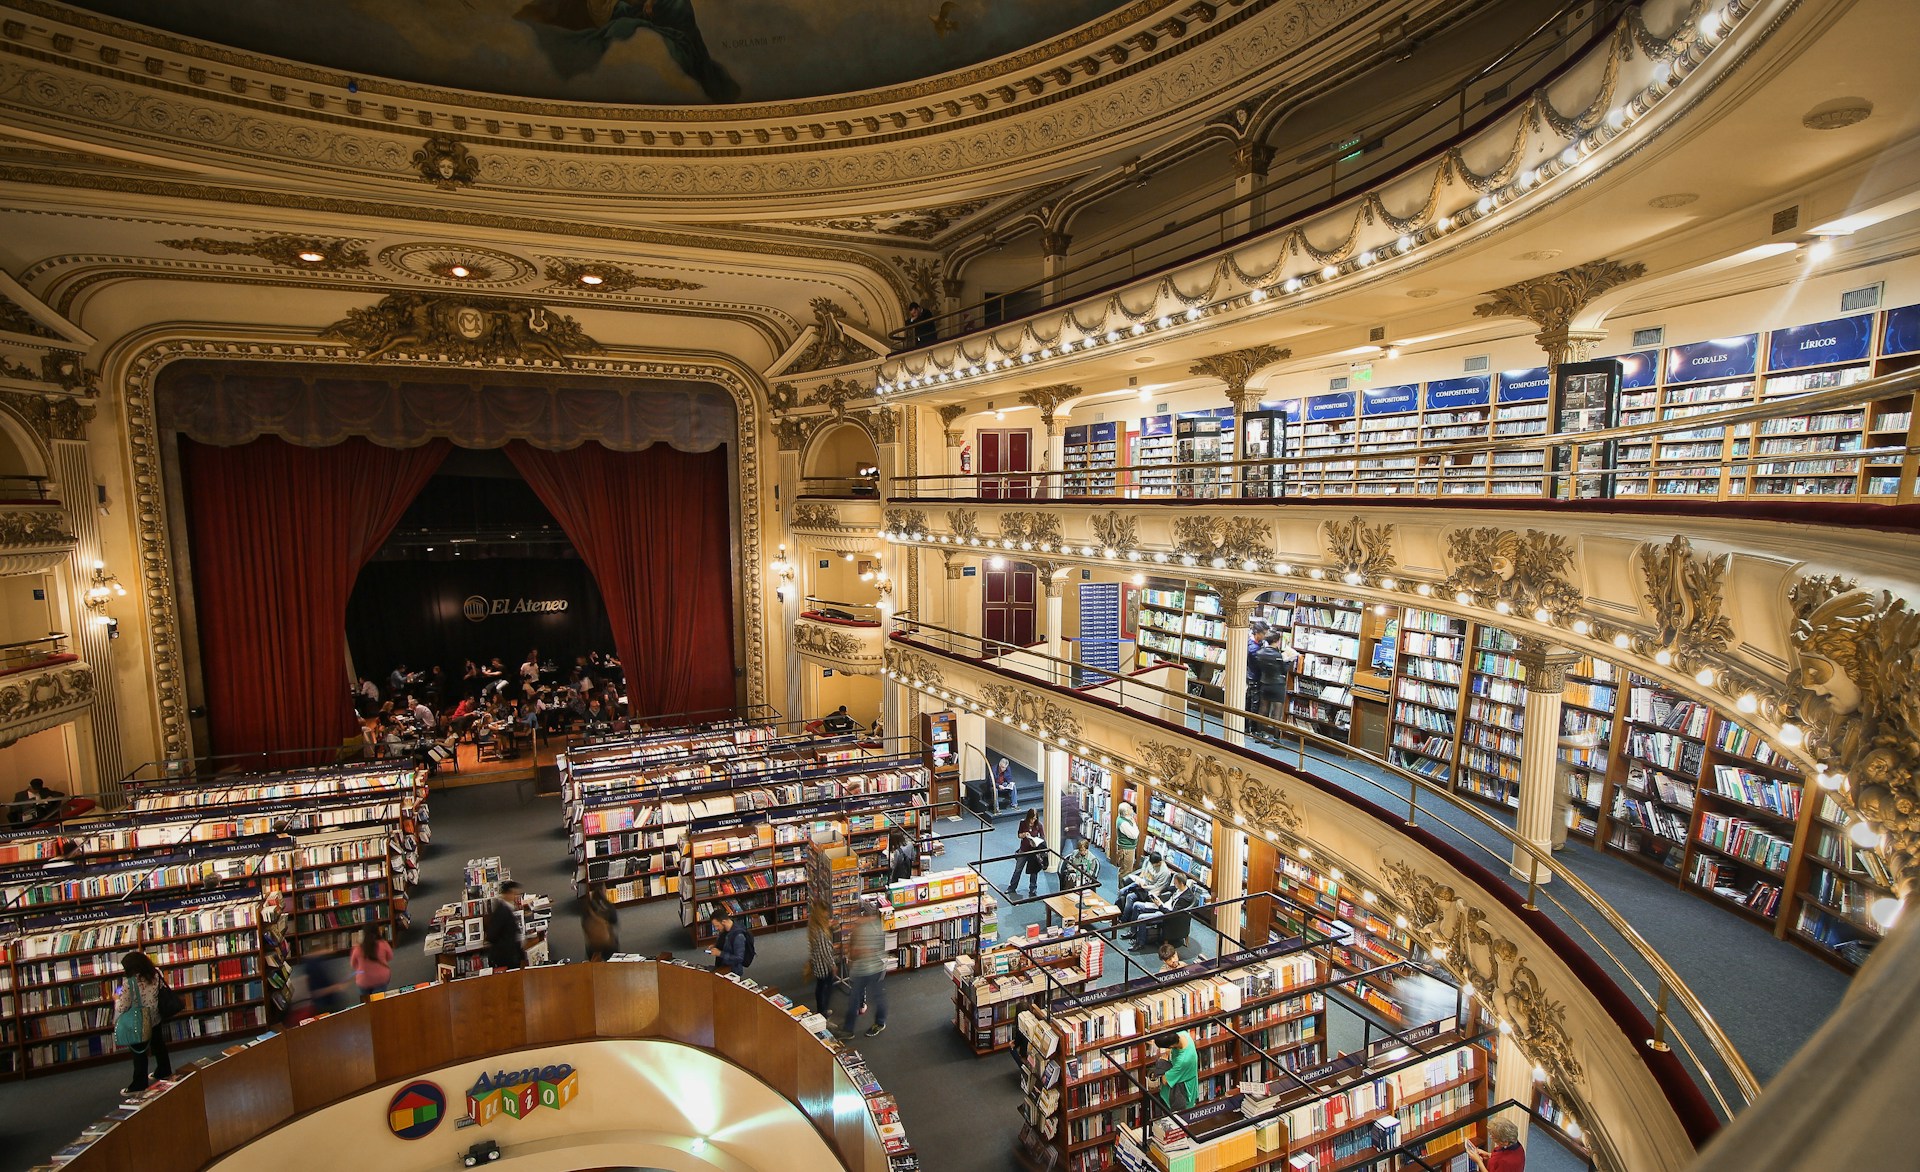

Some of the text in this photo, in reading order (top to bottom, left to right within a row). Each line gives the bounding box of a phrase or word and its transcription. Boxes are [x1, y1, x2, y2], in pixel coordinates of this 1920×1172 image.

[1800, 337, 1836, 350] LÍRICOS
[1692, 354, 1728, 366] CORALES
[1509, 379, 1549, 390] COMPOSITOR
[1435, 387, 1480, 398] COMPOSITORES
[1370, 395, 1410, 405] COMPOSITORES
[1313, 402, 1348, 411] COMPOSITORES
[490, 598, 568, 615] El Ateneo
[795, 807, 818, 815] TURISMO
[80, 822, 116, 831] MITOLOGIA
[718, 818, 742, 826] TURISMO
[227, 843, 261, 852] FILOSOFIA
[120, 857, 157, 868] FILOSOFIA
[11, 871, 49, 880] FILOSOFIA
[180, 894, 227, 906] SOCIOLOGIA
[60, 911, 109, 923] SOCIOLOGIA
[1157, 969, 1190, 983] IOGRAFIAS
[1409, 1032, 1418, 1042] DE
[1417, 1026, 1435, 1039] VIAJE
[1301, 1065, 1333, 1082] DERECHO
[468, 1064, 573, 1096] Ateneo
[468, 1078, 577, 1120] Junior
[1189, 1103, 1226, 1121] DERECHO
